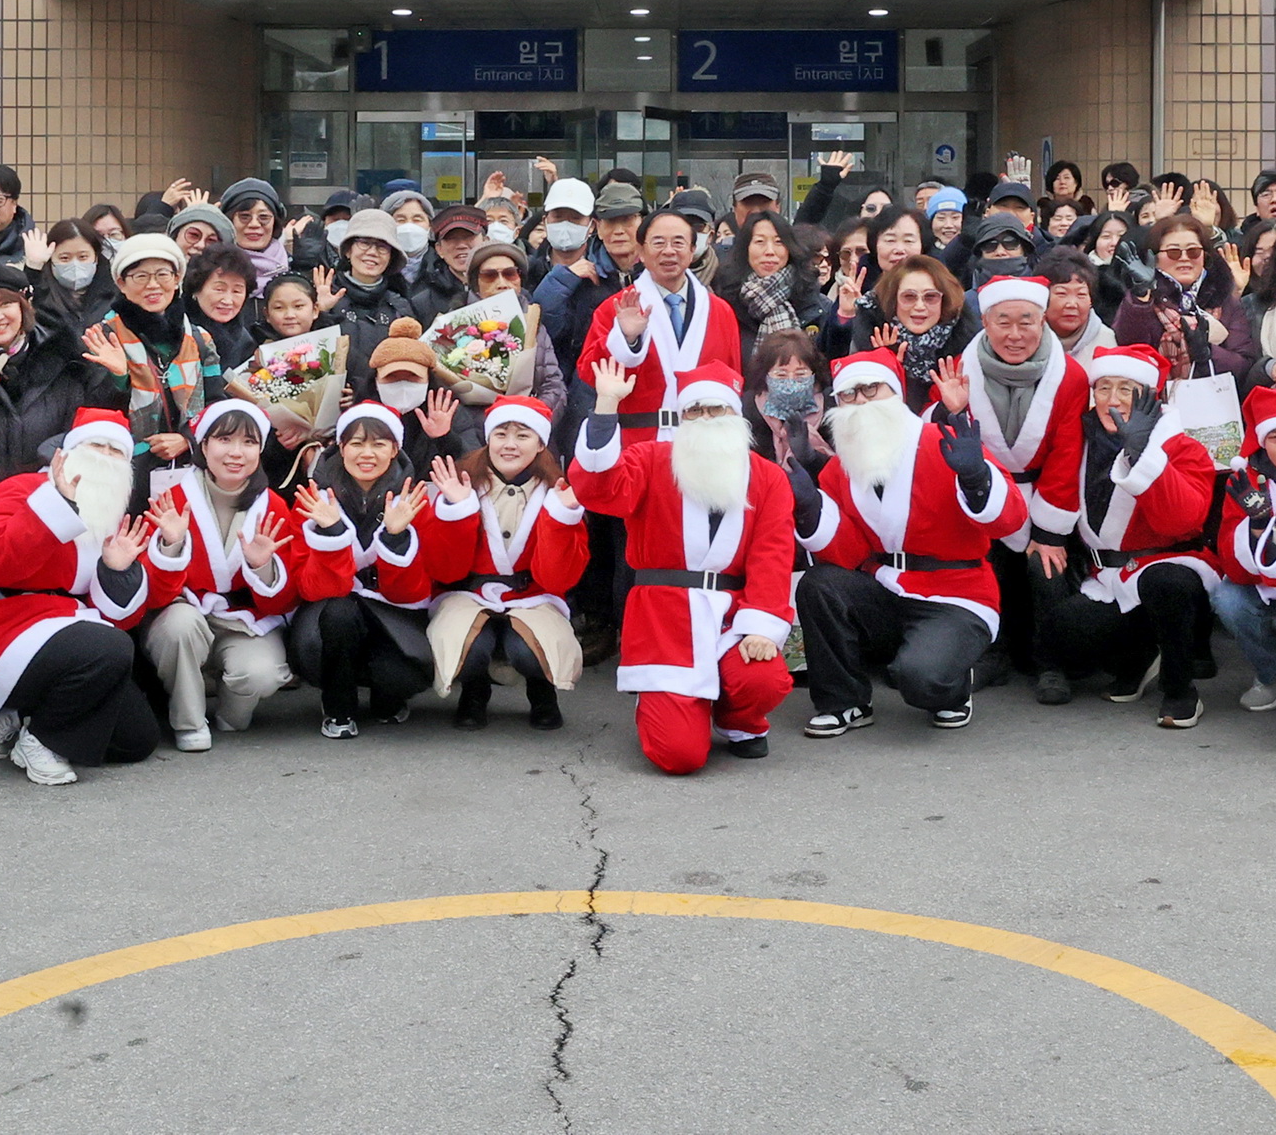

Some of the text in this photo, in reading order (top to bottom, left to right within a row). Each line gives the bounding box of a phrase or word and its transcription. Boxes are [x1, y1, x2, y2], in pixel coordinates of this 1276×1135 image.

[373, 40, 389, 81] 1
[519, 40, 564, 64] 입구
[691, 39, 718, 81] 2
[838, 39, 884, 64] 입구
[474, 68, 533, 81] Entrance
[794, 67, 853, 81] Entrance
